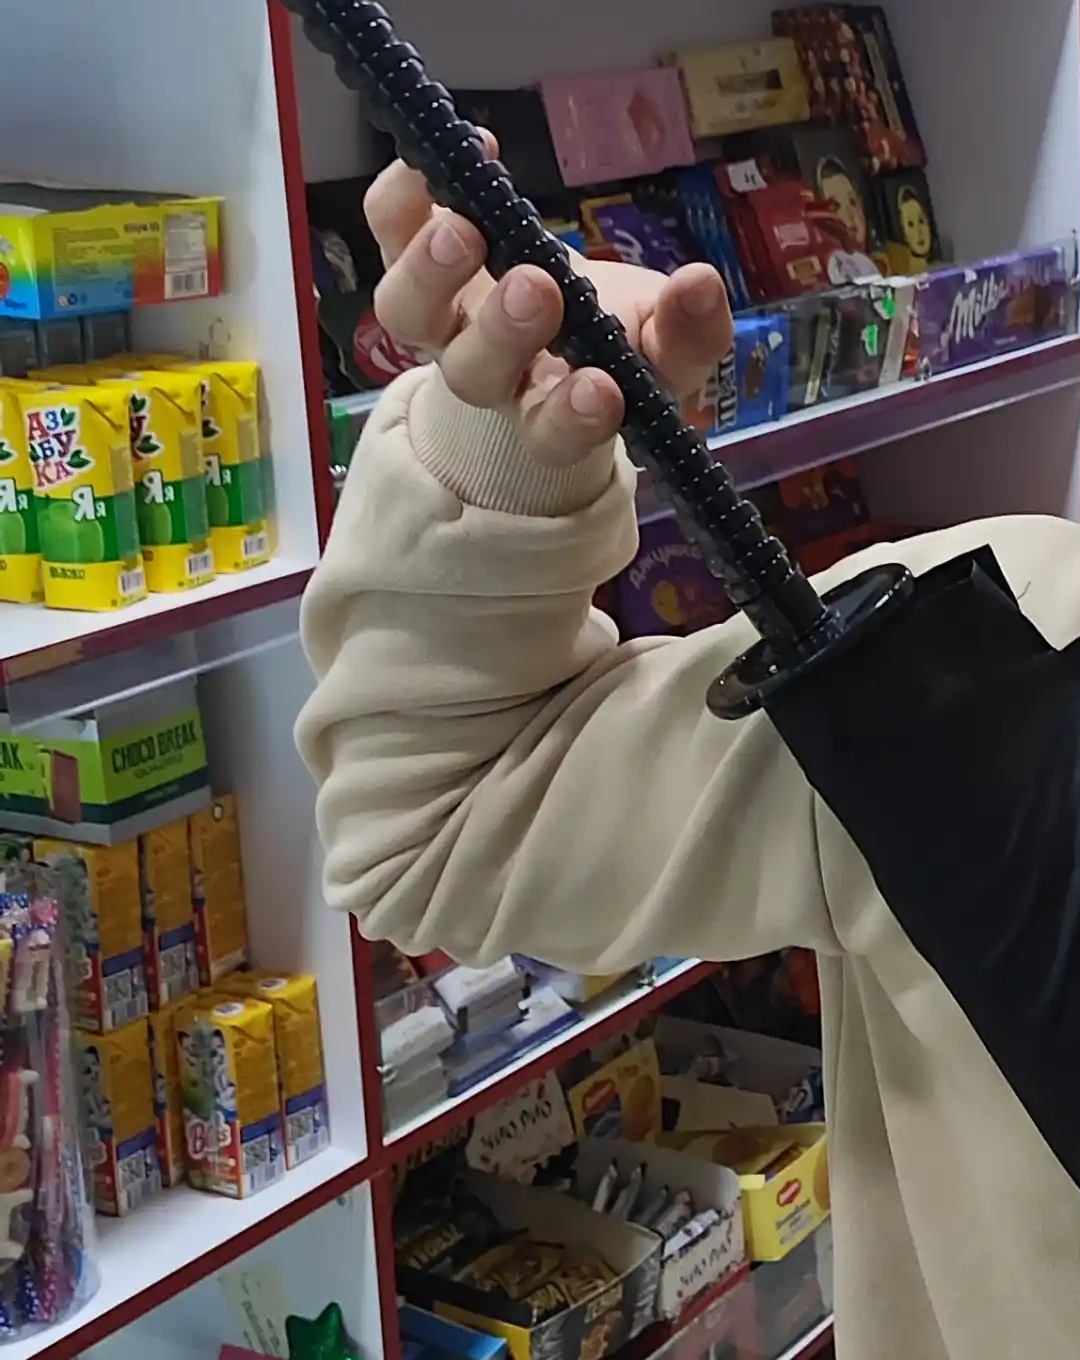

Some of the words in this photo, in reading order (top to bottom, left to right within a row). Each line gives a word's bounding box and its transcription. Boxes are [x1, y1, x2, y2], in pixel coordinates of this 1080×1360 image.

[27, 410, 60, 441] АЗ
[38, 429, 77, 460] БУ
[33, 460, 75, 488] КА
[111, 736, 155, 774] CHOCO
[156, 719, 198, 755] BREAK
